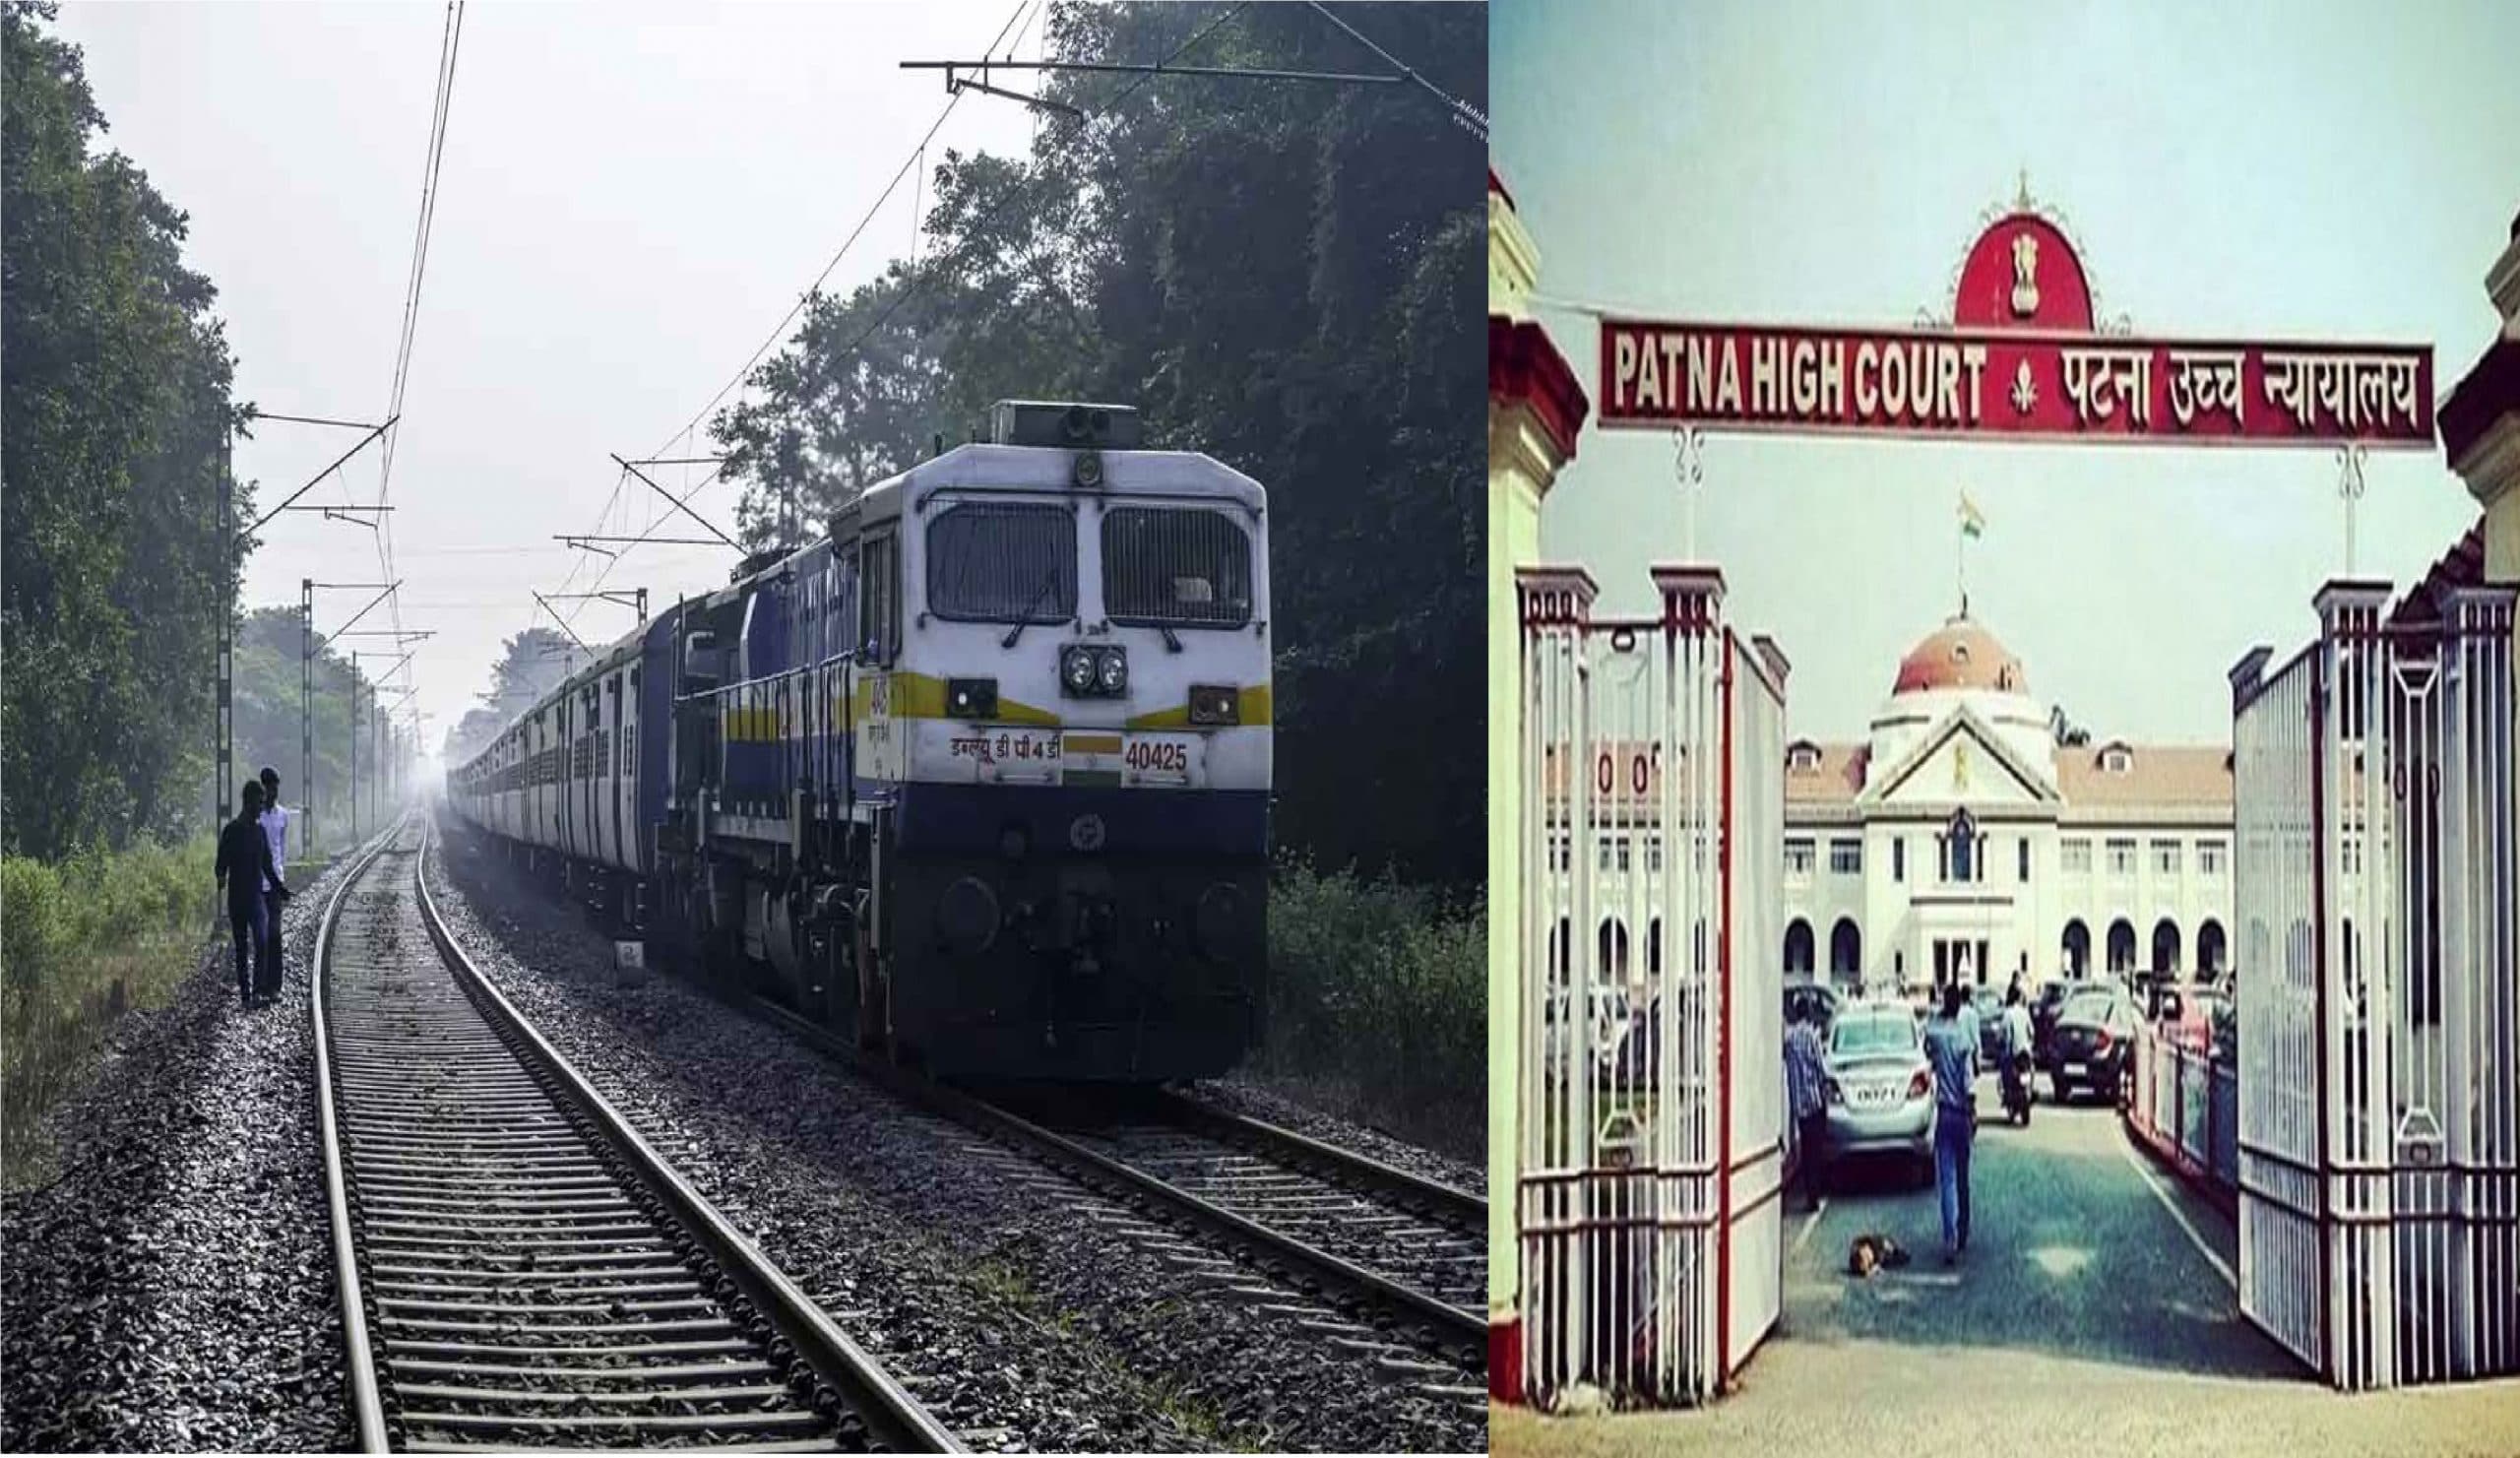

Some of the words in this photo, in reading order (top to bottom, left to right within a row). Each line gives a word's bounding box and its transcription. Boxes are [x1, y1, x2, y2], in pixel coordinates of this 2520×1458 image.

[1614, 332, 1741, 412] PATNA
[1752, 338, 1844, 414] HIGH
[1855, 341, 1986, 419] COURT
[2061, 349, 2153, 422] पटना
[2170, 351, 2245, 425] उच्च
[2262, 353, 2420, 428] न्यायालय
[995, 733, 1009, 758] डी
[1126, 741, 1186, 770] 40425
